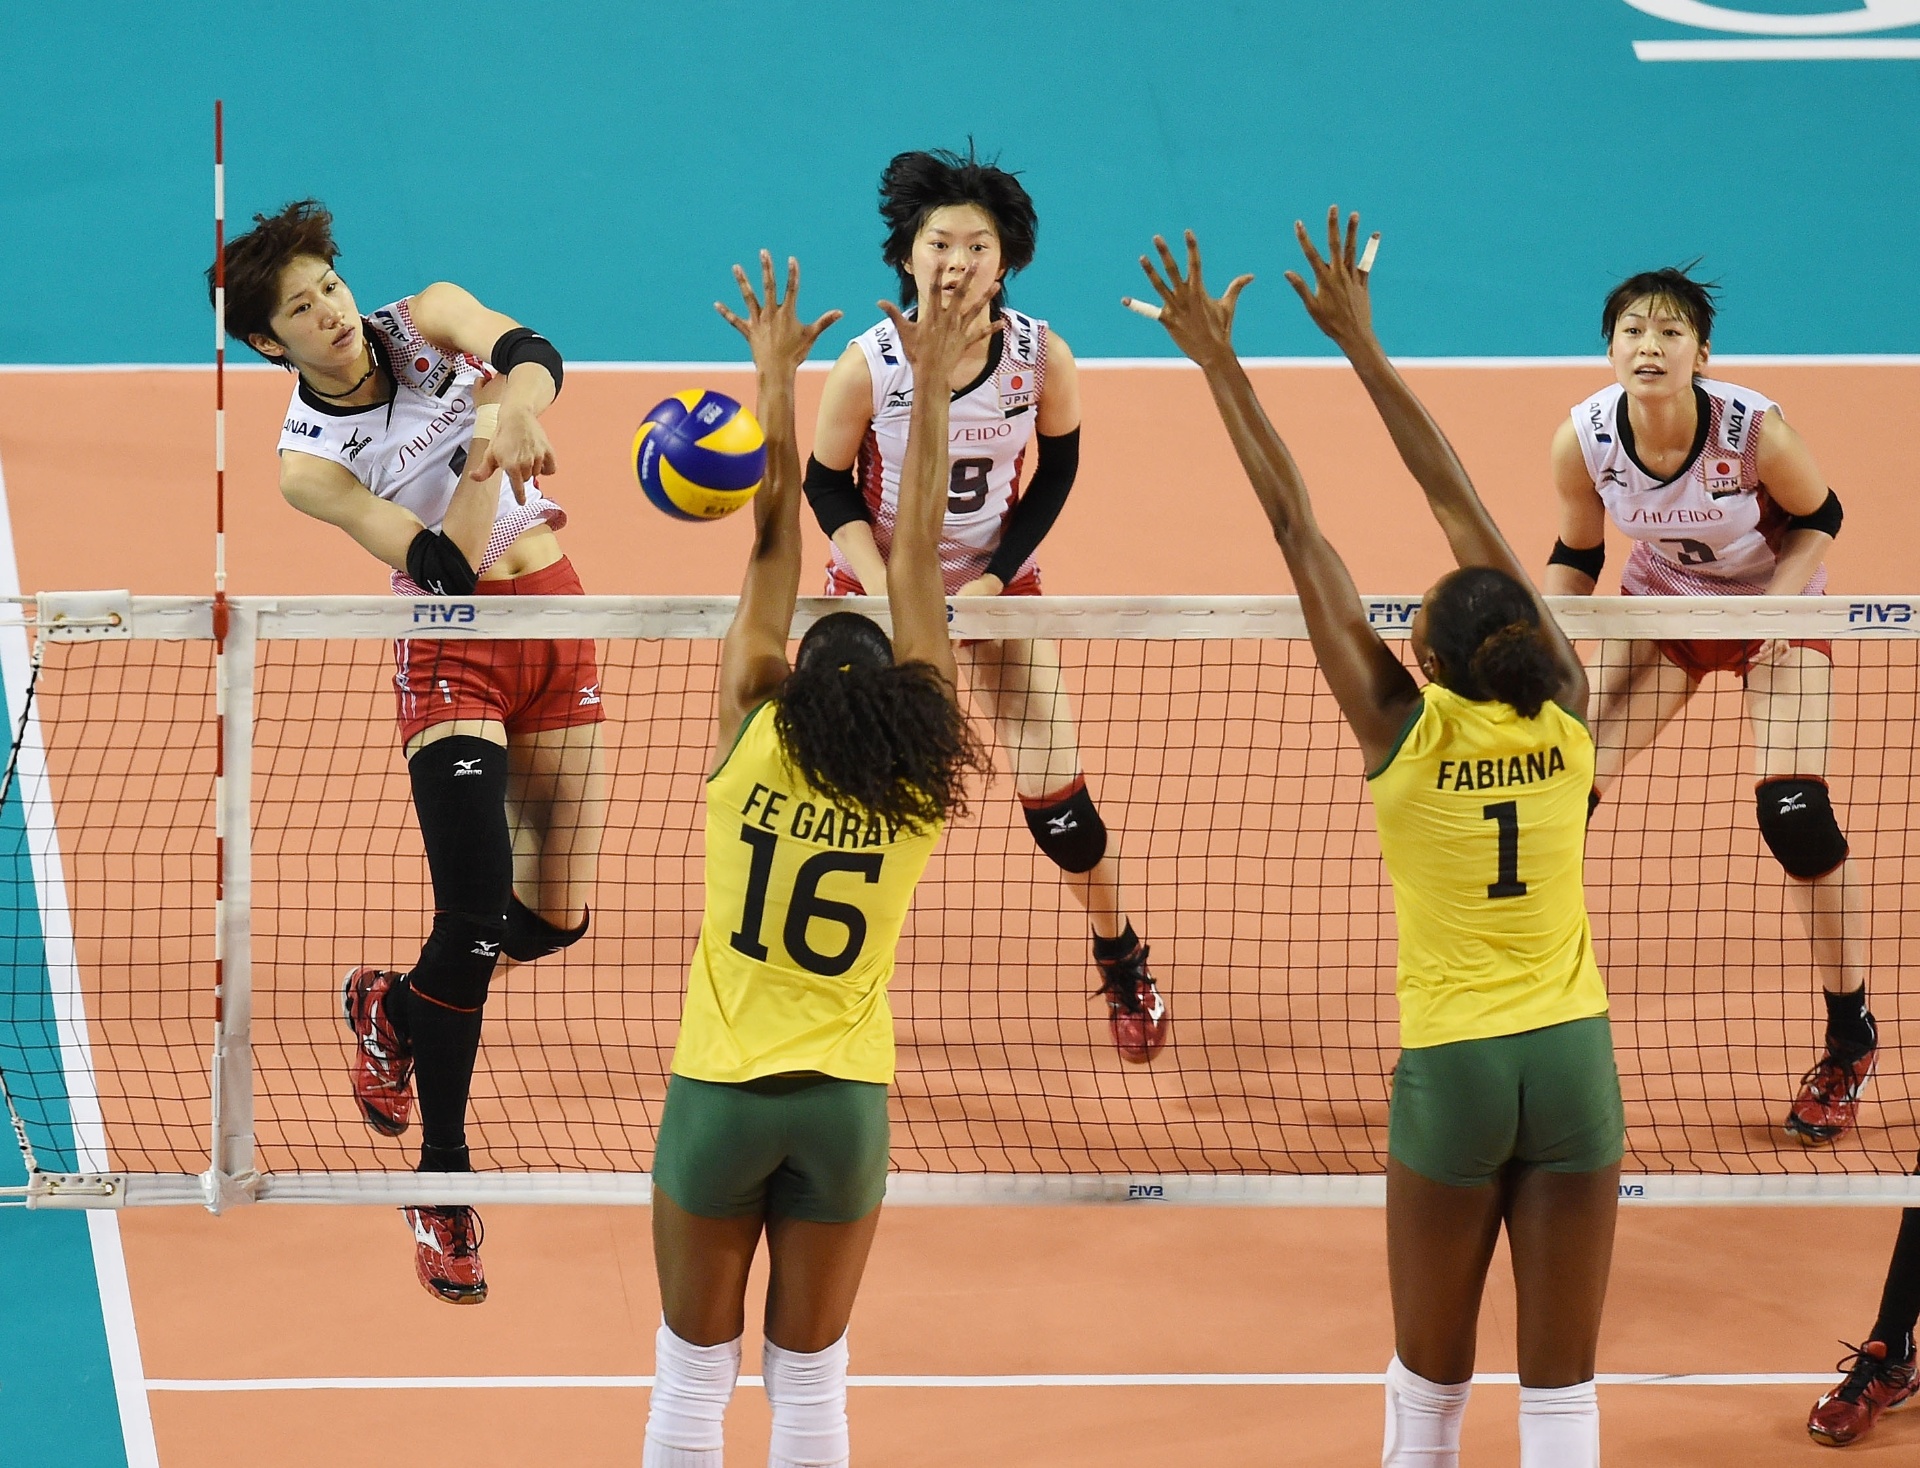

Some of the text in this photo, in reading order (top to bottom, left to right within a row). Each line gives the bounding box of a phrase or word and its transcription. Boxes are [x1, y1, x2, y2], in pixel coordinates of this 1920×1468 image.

[873, 326, 893, 356] ANA
[1017, 324, 1032, 361] ANA
[427, 363, 449, 389] JPN
[1005, 394, 1029, 406] JPN
[283, 418, 308, 436] ANA
[1589, 402, 1606, 432] ANA
[395, 398, 466, 474] SHISEIDO
[949, 423, 1012, 441] SEIDO
[1726, 414, 1745, 450] ANA
[947, 458, 994, 515] 9
[1712, 479, 1739, 489] JPN
[1623, 508, 1723, 524] SHISEIDO
[413, 604, 475, 622] FIVB
[1849, 604, 1911, 622] FIVB
[1437, 746, 1566, 791] FABIANA
[741, 782, 787, 831] FE
[1483, 800, 1527, 899] 1
[730, 823, 884, 977] 16
[1129, 1185, 1163, 1196] FIVB
[1618, 1185, 1644, 1196] IVB
